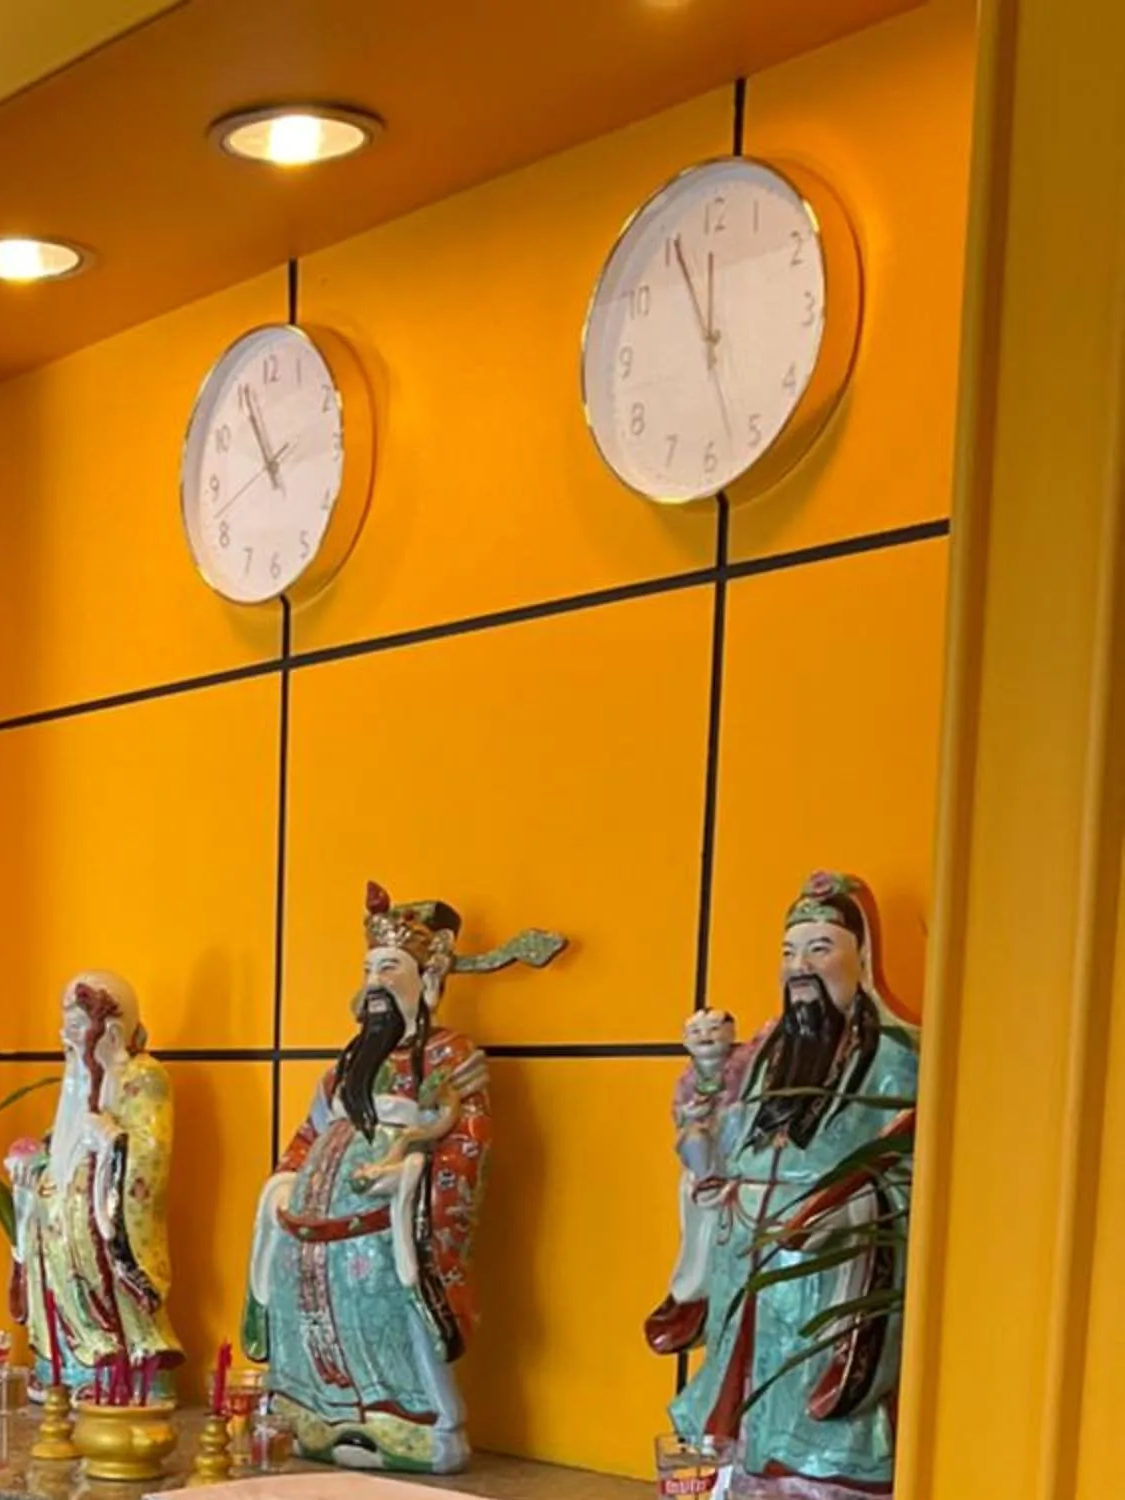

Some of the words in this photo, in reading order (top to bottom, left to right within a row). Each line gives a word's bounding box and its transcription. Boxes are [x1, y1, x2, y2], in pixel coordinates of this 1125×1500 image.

[704, 198, 726, 234] 12
[791, 230, 804, 266] 2
[626, 286, 651, 320] 10
[803, 291, 815, 327] 3
[263, 354, 279, 384] 12
[619, 347, 634, 379] 9
[782, 365, 797, 396] 4
[321, 384, 331, 412] 2
[631, 402, 646, 436] 8
[746, 414, 762, 448] 5
[663, 435, 679, 468] 7
[704, 441, 718, 473] 6
[210, 474, 220, 501] 9
[219, 522, 231, 549] 8
[299, 531, 310, 559] 5
[244, 548, 253, 575] 7
[269, 553, 281, 579] 6
